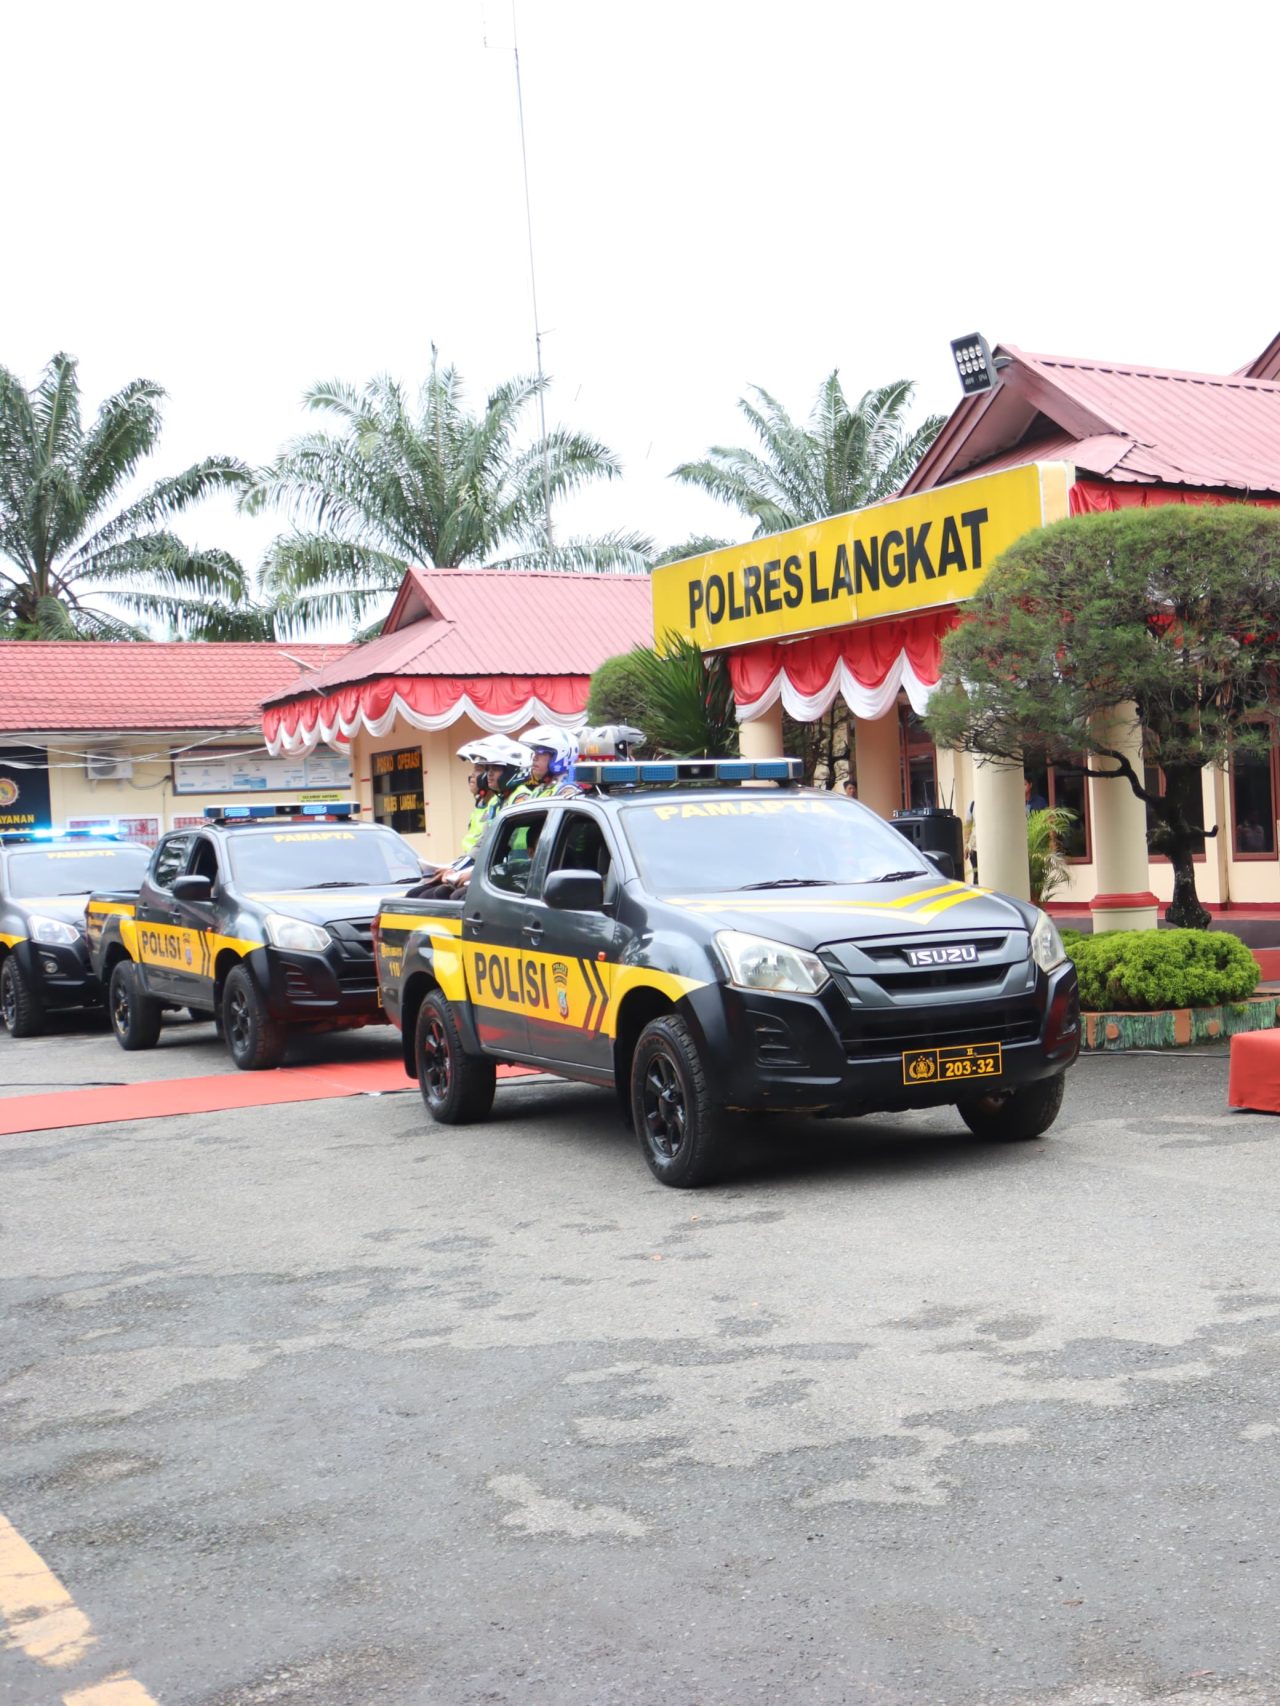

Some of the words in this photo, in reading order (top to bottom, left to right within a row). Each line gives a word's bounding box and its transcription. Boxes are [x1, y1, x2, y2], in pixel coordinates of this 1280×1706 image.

[688, 554, 804, 629] POLRES
[809, 506, 989, 604] LANGKAT
[654, 800, 838, 821] PAMAPTA
[273, 831, 355, 843] PAMAPTA
[141, 930, 182, 960] POLISI
[910, 947, 977, 966] ISUZU
[474, 952, 550, 1009] POLISI
[945, 1058, 995, 1077] 203-32
